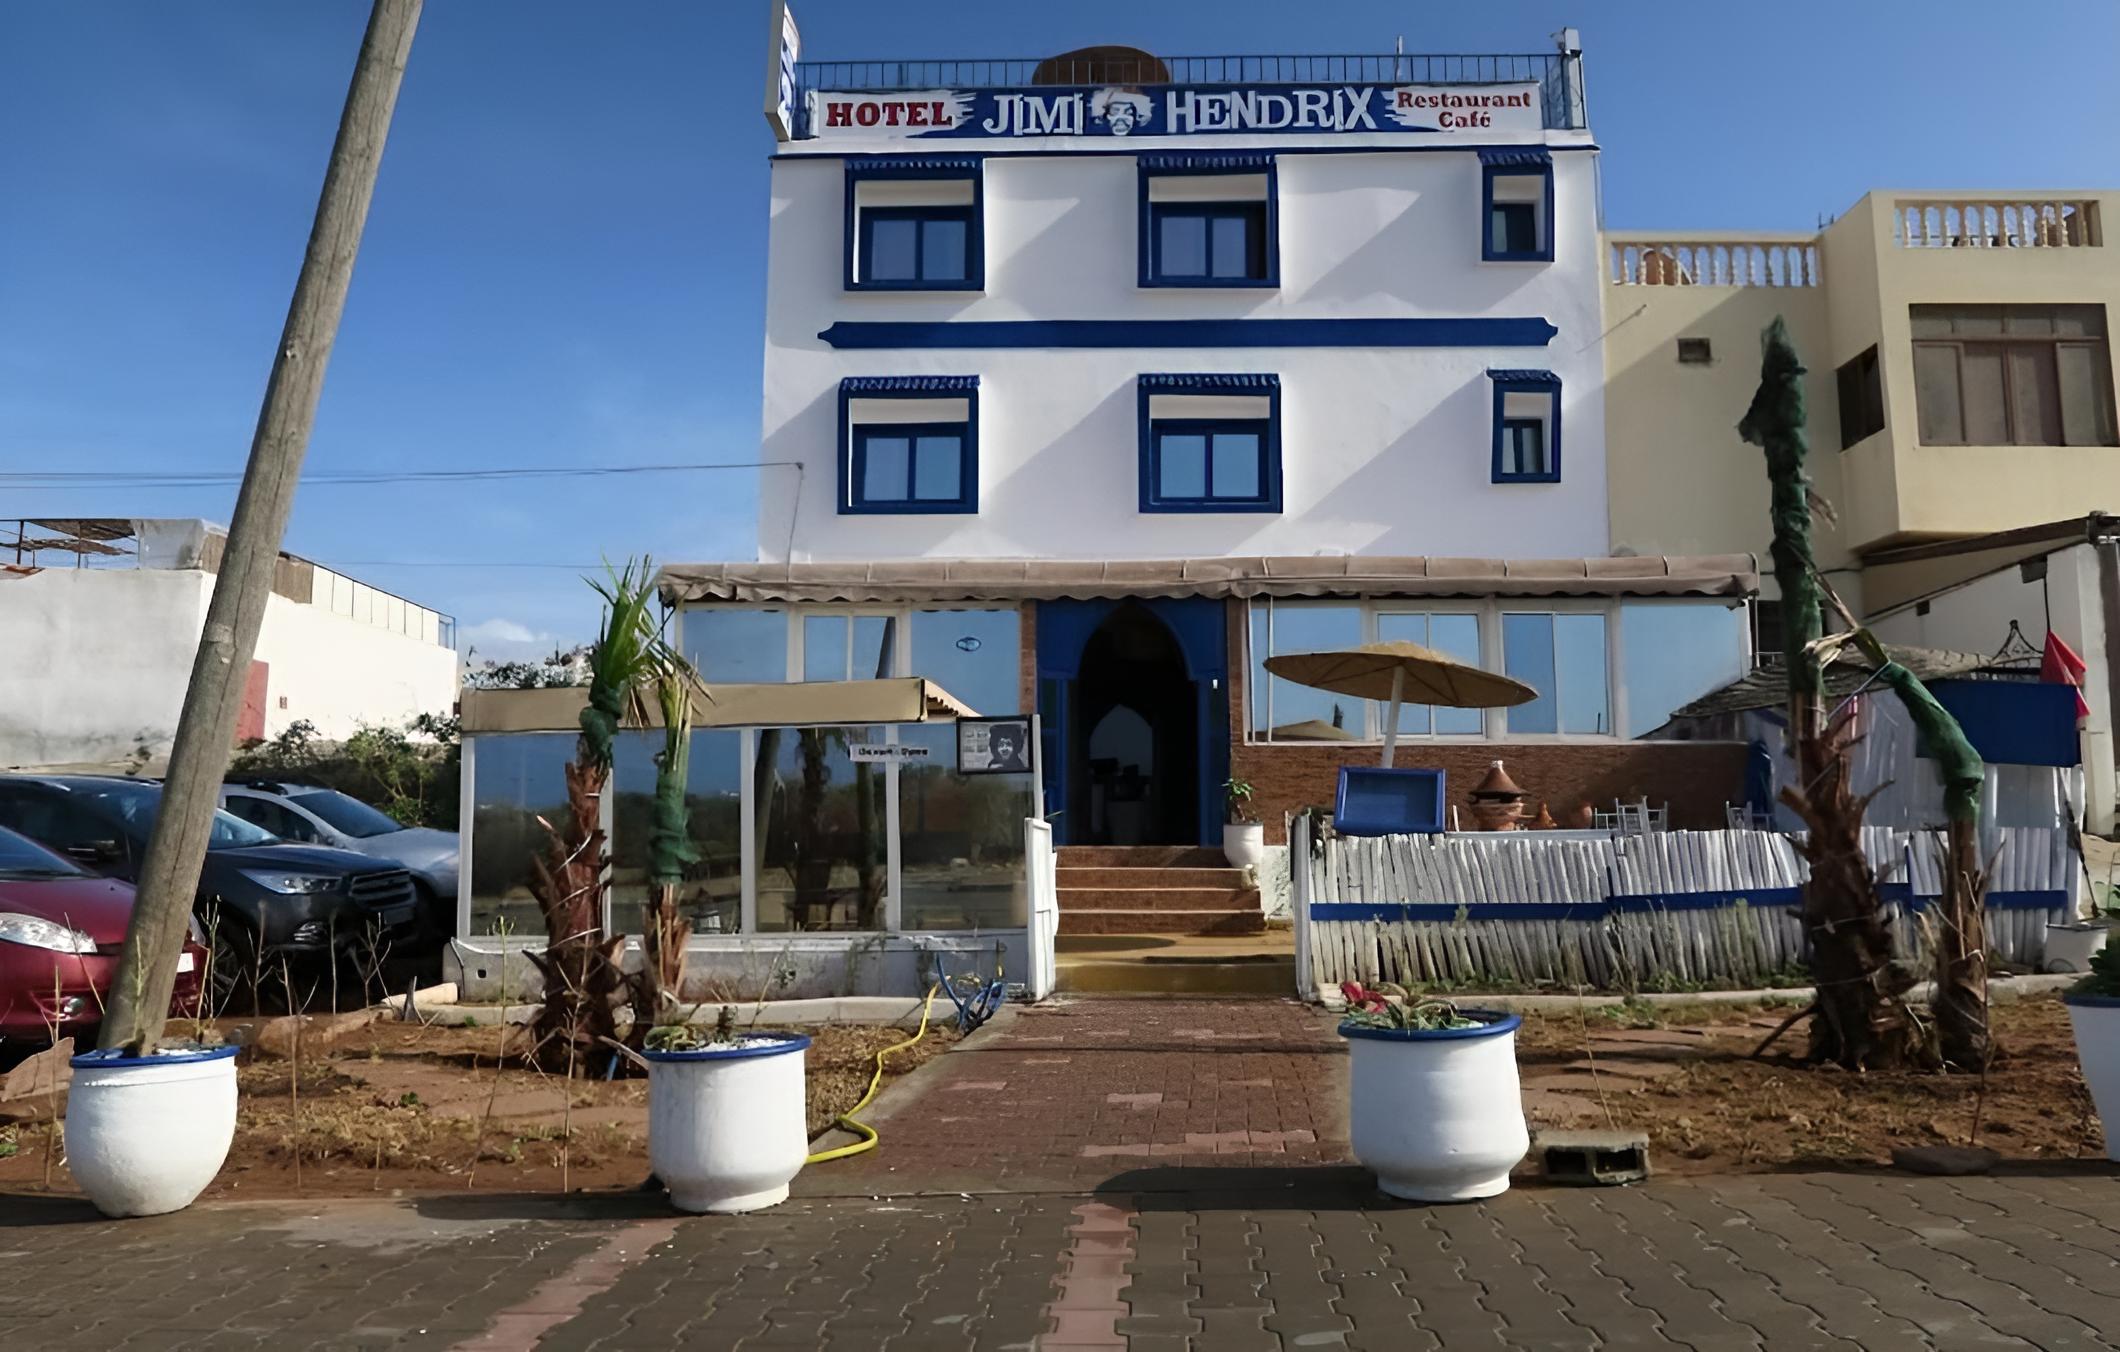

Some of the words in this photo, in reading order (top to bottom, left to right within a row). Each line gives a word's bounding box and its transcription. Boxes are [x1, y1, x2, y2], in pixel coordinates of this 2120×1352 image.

[1397, 91, 1531, 108] Restaurant
[825, 102, 953, 127] HOTEL
[982, 93, 1084, 136] JIMI
[1166, 87, 1378, 133] HENDRIX
[1438, 111, 1491, 128] Café
